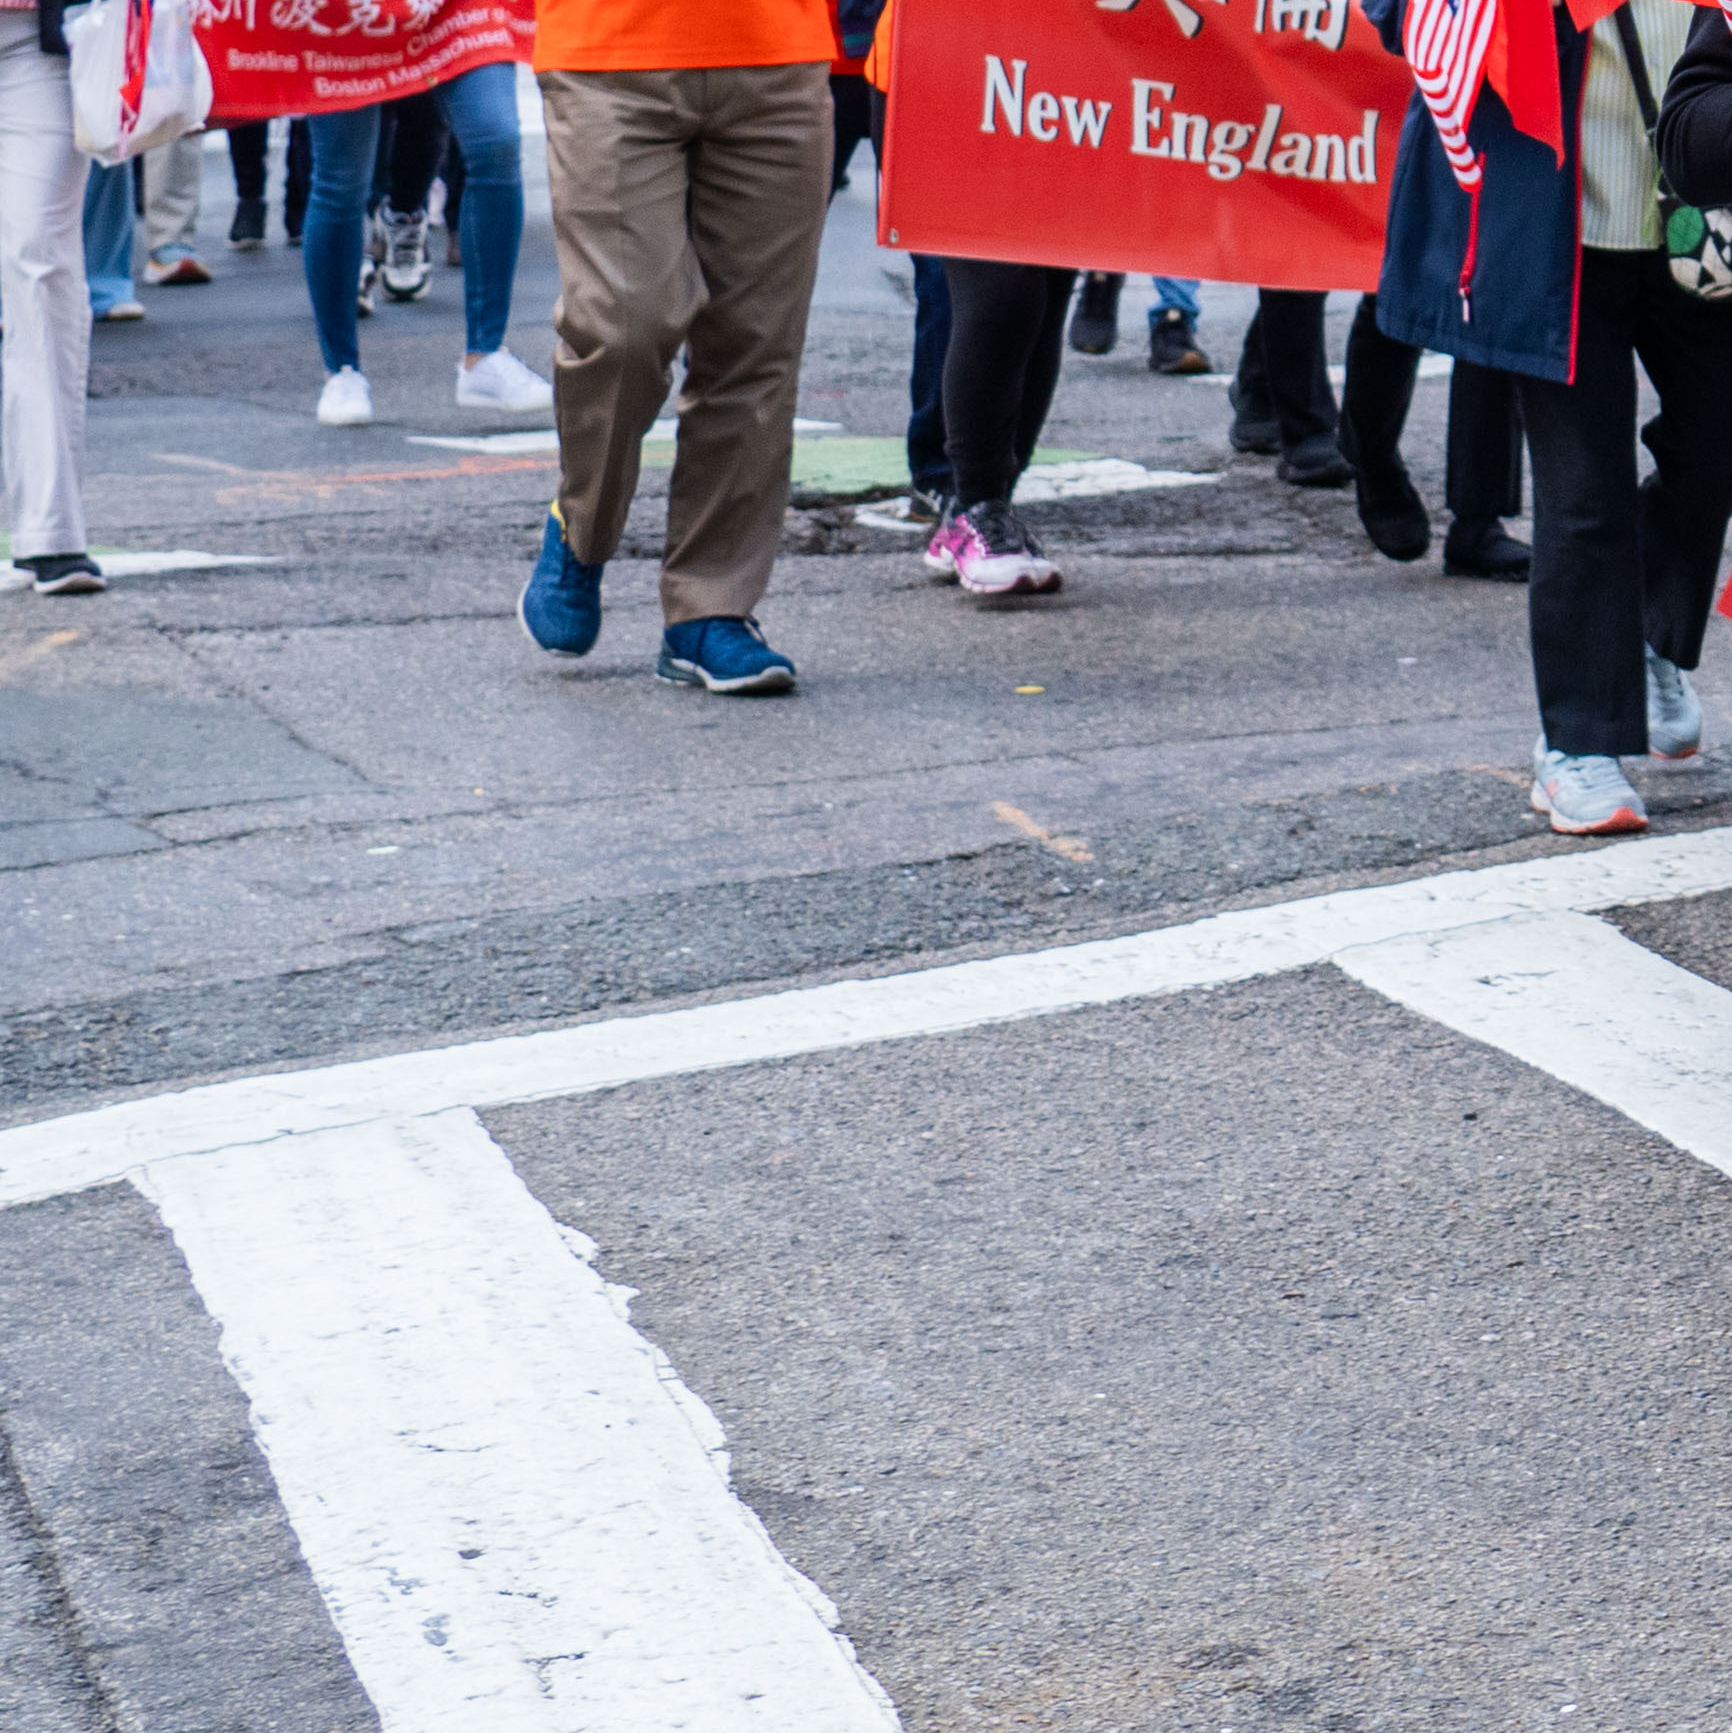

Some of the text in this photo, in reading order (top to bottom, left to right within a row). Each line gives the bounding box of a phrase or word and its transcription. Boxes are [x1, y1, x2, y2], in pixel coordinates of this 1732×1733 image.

[405, 8, 490, 56] Chamber
[314, 74, 387, 98] Boston
[981, 55, 1379, 183] New England
